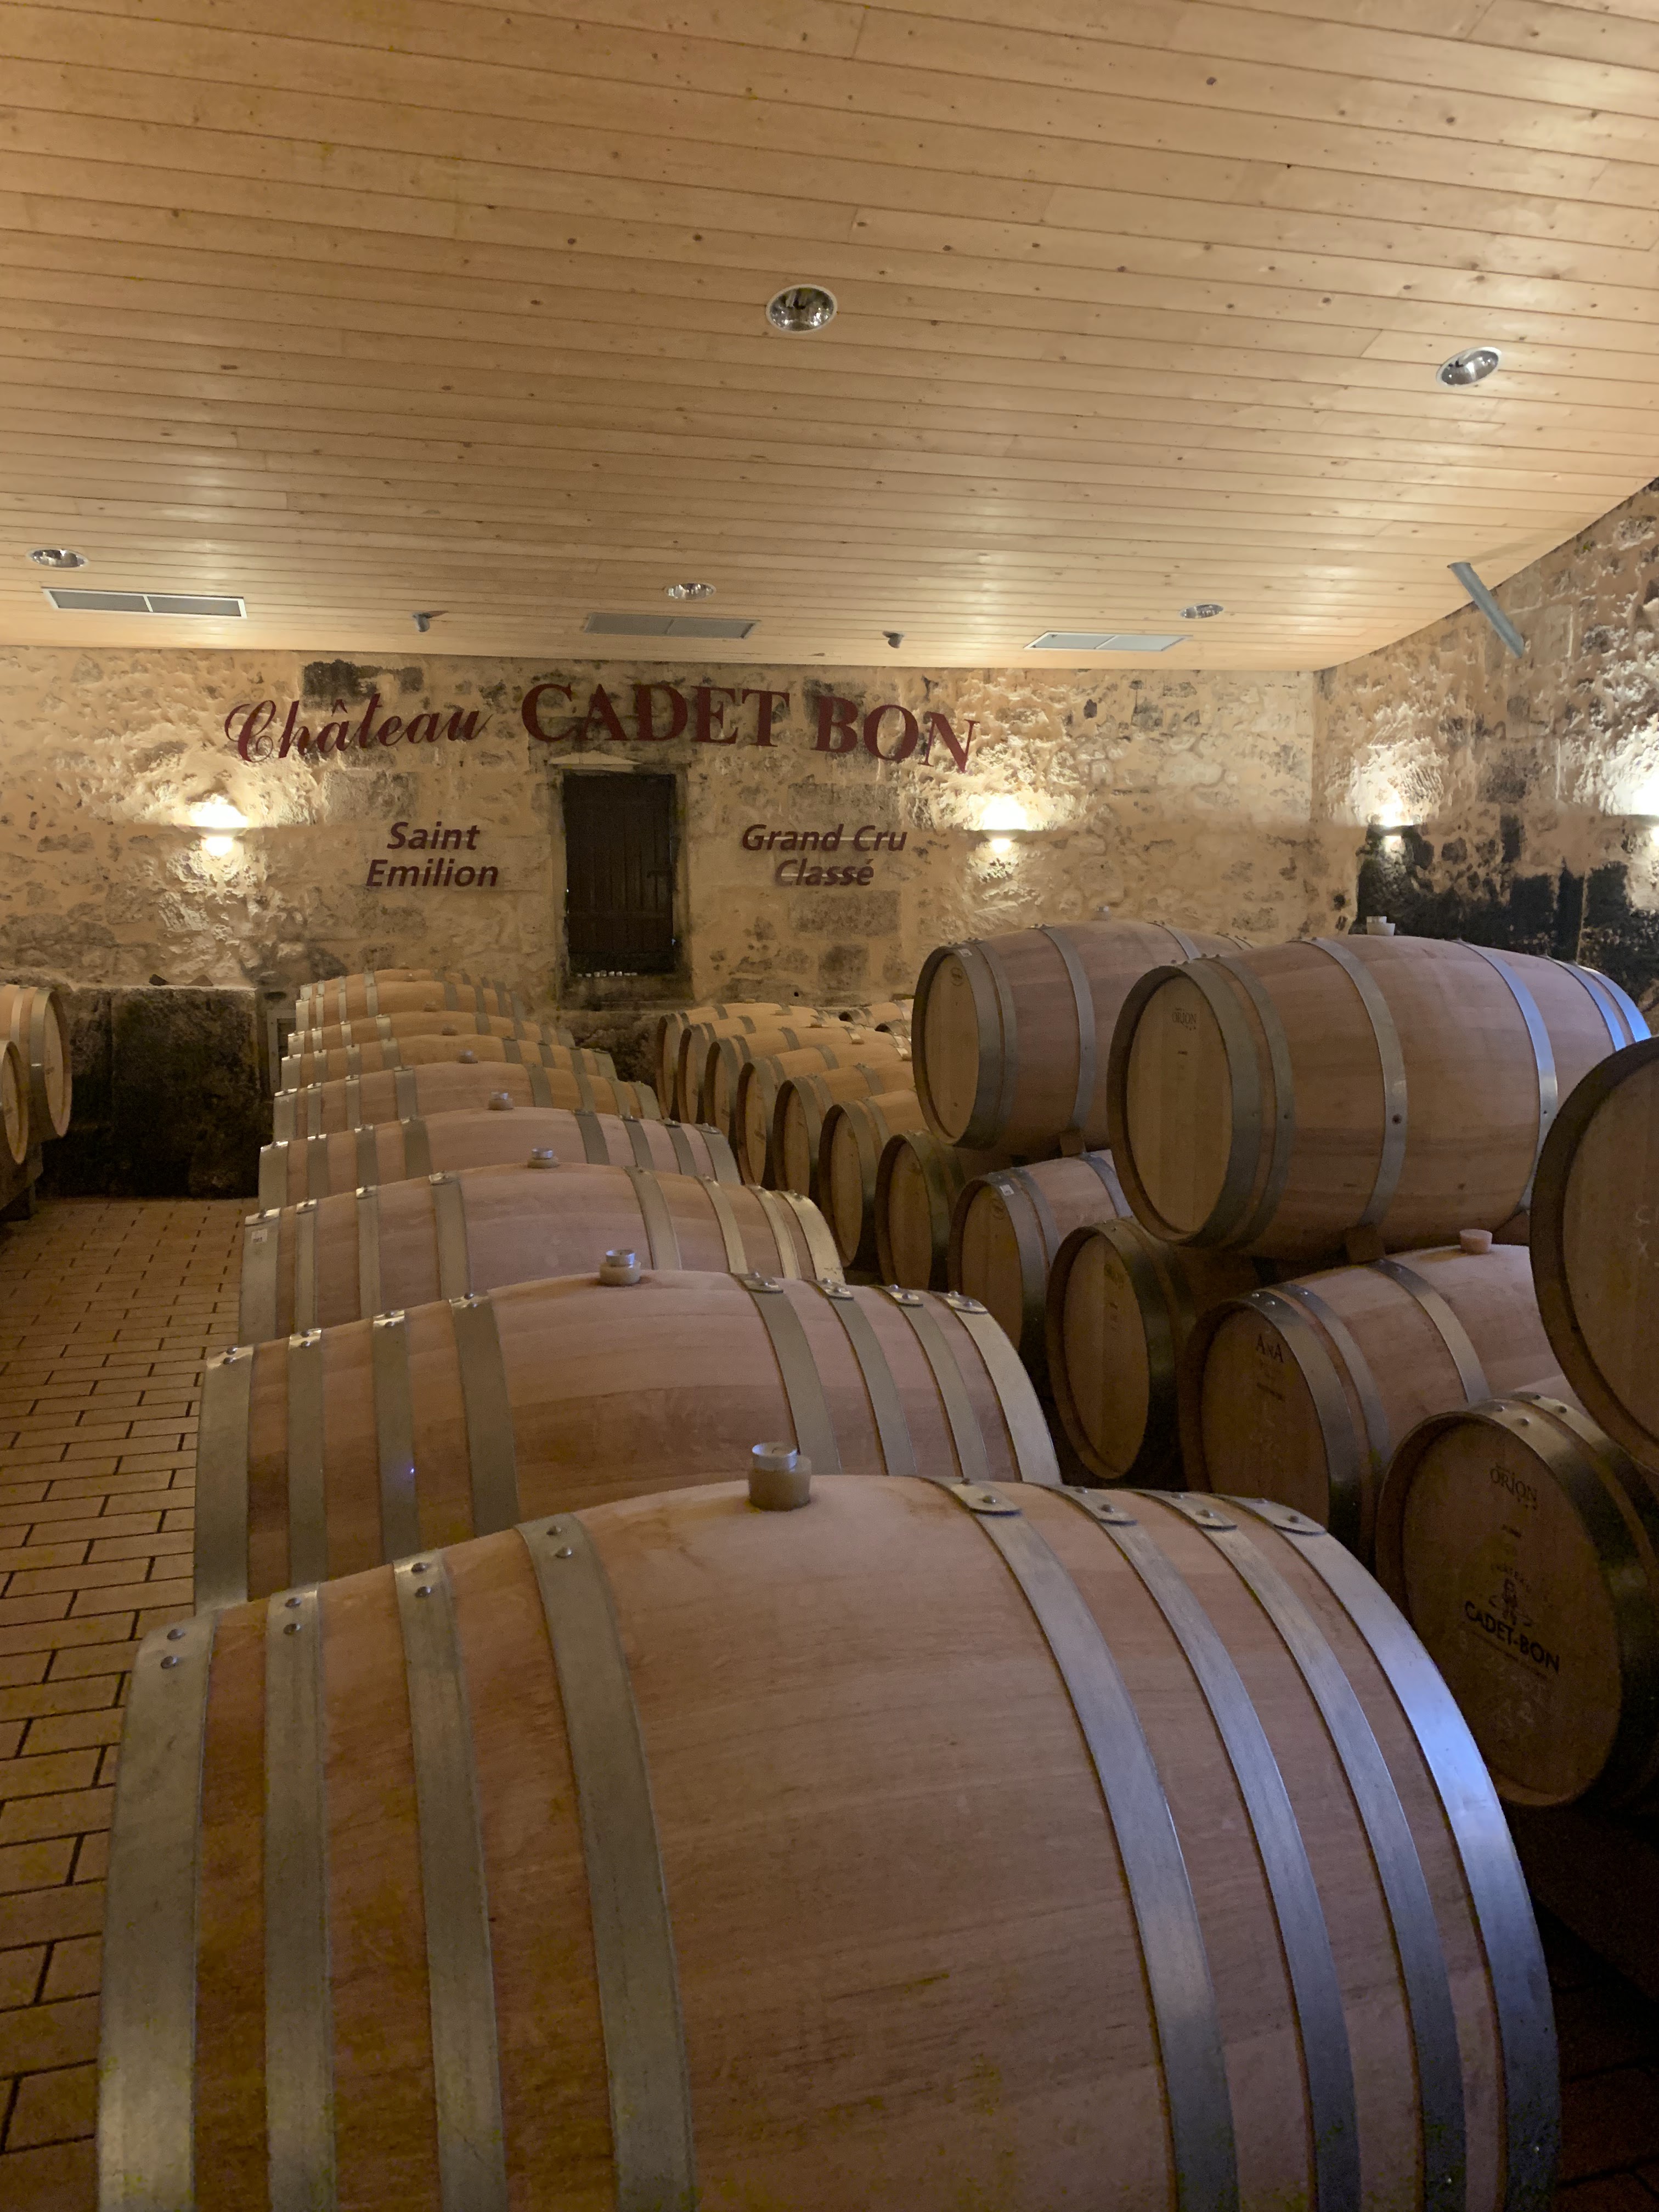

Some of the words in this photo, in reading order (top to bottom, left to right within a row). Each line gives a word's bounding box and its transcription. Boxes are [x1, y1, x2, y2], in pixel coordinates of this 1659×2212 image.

[224, 693, 492, 763] Château
[522, 683, 790, 747] CADET
[811, 695, 980, 772] BON
[387, 821, 480, 850] Saint
[742, 823, 844, 852] Grand
[853, 825, 907, 852] Cru
[365, 858, 498, 888] Emilion
[775, 857, 876, 887] Classé
[1464, 1600, 1560, 1672] CADET-BON
